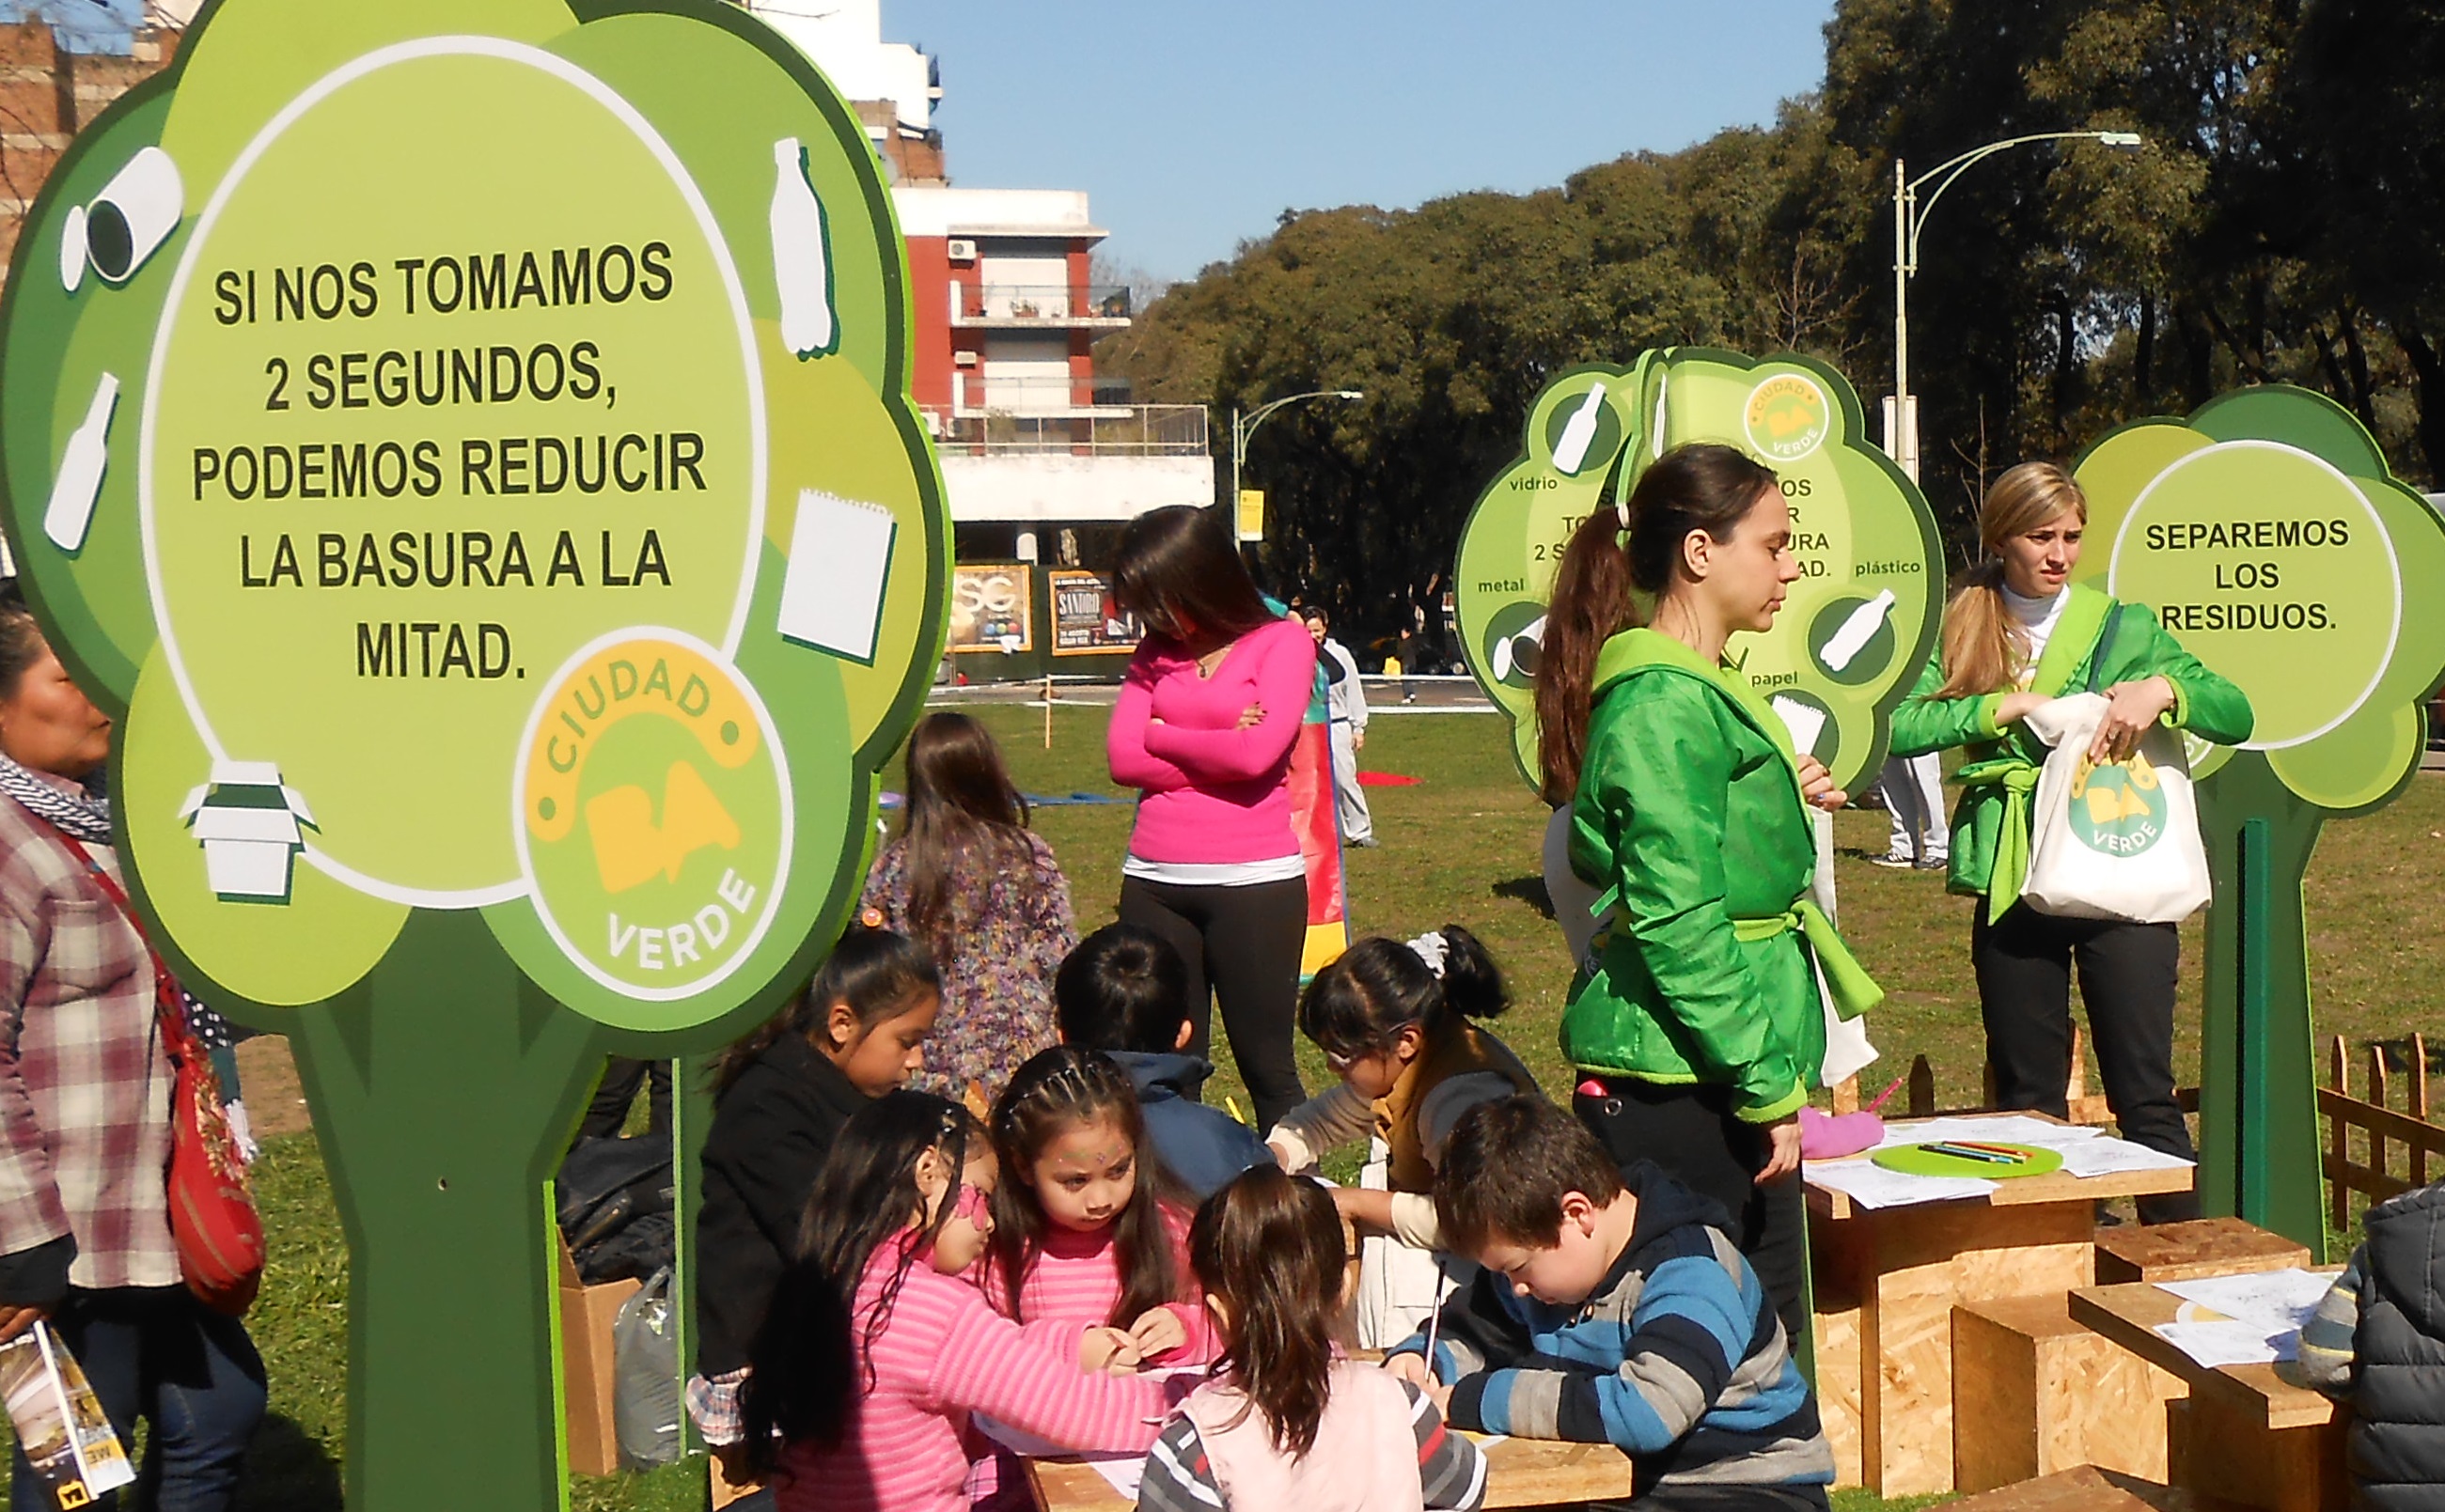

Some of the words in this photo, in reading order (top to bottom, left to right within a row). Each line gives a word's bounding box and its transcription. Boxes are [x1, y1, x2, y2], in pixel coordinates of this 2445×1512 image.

[214, 270, 256, 325] SI
[274, 261, 378, 322] NOS
[394, 242, 673, 315] TOMAMOS
[265, 357, 290, 412] 2
[306, 341, 616, 410] SEGUNDOS,
[1754, 382, 1805, 411] CIUDAD
[1773, 427, 1819, 455] VERDE
[194, 440, 442, 501] PODEMOS
[462, 432, 708, 496] REDUCIR
[1510, 476, 1558, 491] vidrio
[2146, 519, 2349, 551] SEPAREMOS
[241, 534, 304, 587] LA
[318, 531, 535, 588] BASURA
[546, 530, 585, 587] A
[602, 529, 672, 587] LA
[1534, 544, 1545, 561] 2
[1856, 560, 1920, 577] plástico
[2216, 562, 2280, 589] LOS
[1478, 577, 1525, 593] metal
[2162, 603, 2336, 631] RESIDUOS.
[356, 622, 525, 679] MITAD.
[1751, 671, 1798, 688] papel
[546, 658, 710, 773] CIUDAD
[2092, 820, 2158, 853] VERDE
[608, 867, 757, 970] VERDE
